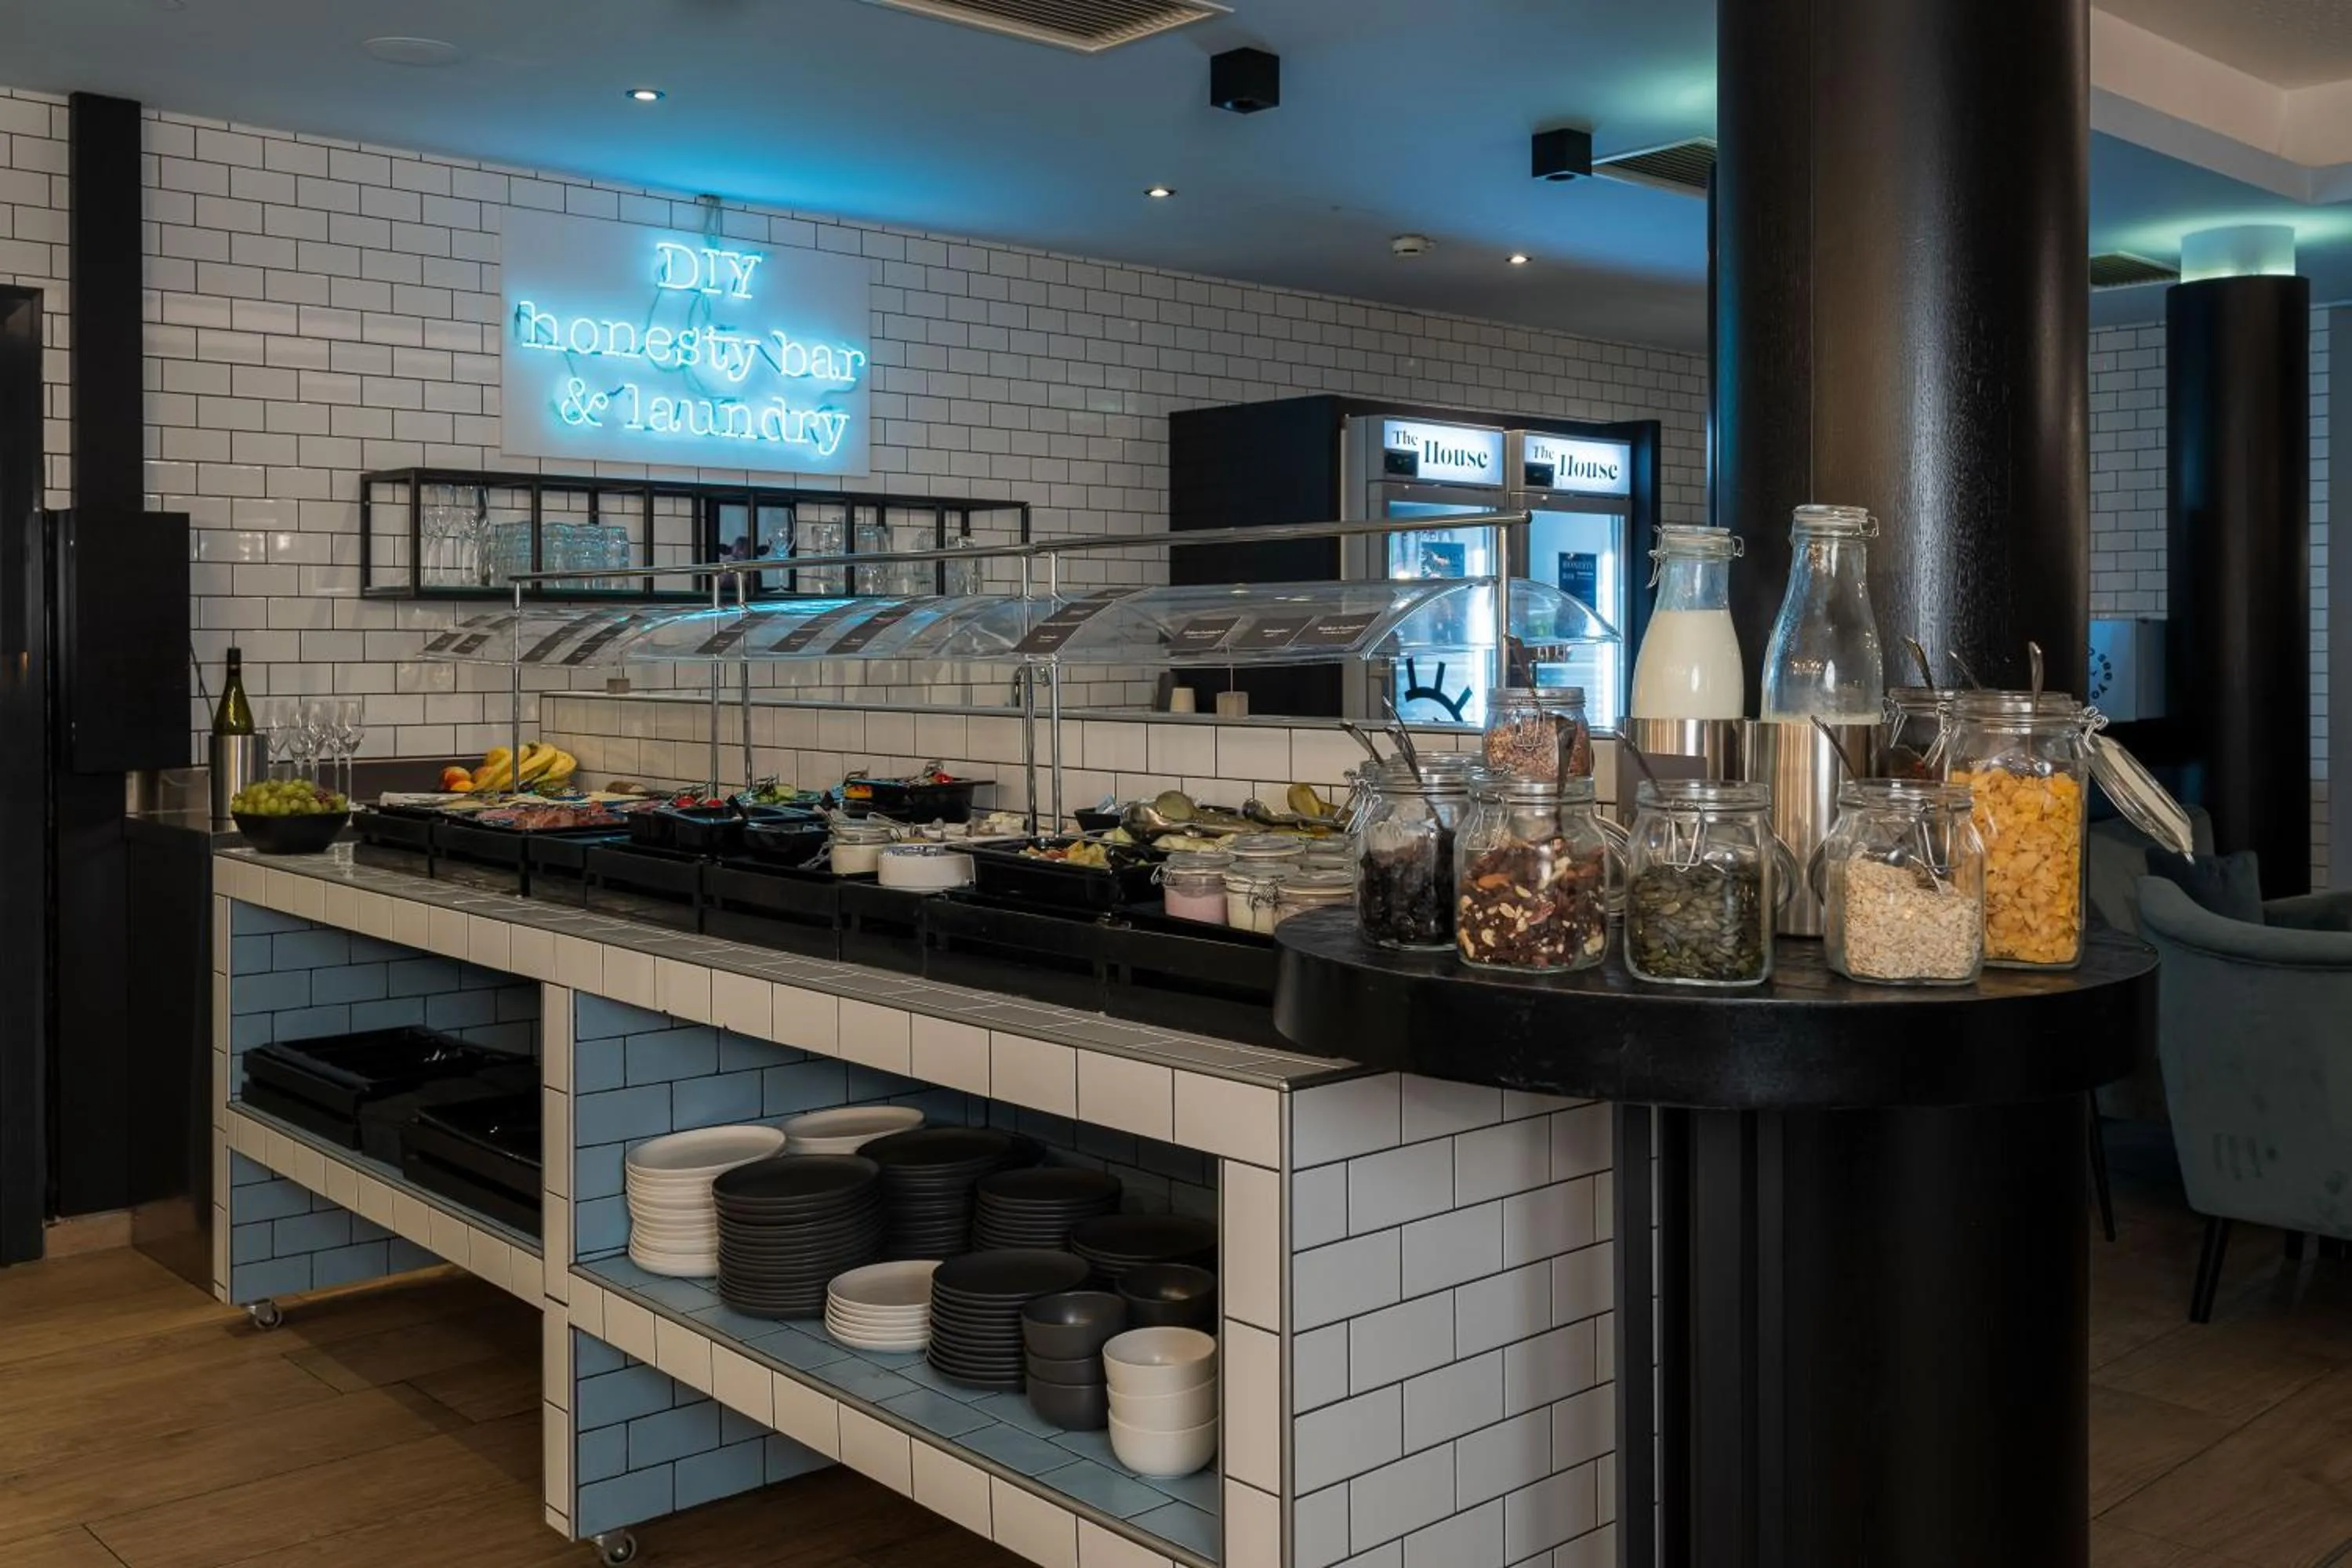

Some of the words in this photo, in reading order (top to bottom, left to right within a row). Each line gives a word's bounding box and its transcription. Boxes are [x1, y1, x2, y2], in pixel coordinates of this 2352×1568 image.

[655, 241, 763, 299] DIY
[519, 299, 761, 383] honesty
[770, 329, 866, 383] bar
[560, 376, 609, 428] &
[623, 383, 851, 457] laundry
[1392, 429, 1419, 447] The
[1533, 445, 1555, 460] The
[1424, 440, 1489, 469] House
[1559, 454, 1618, 481] House
